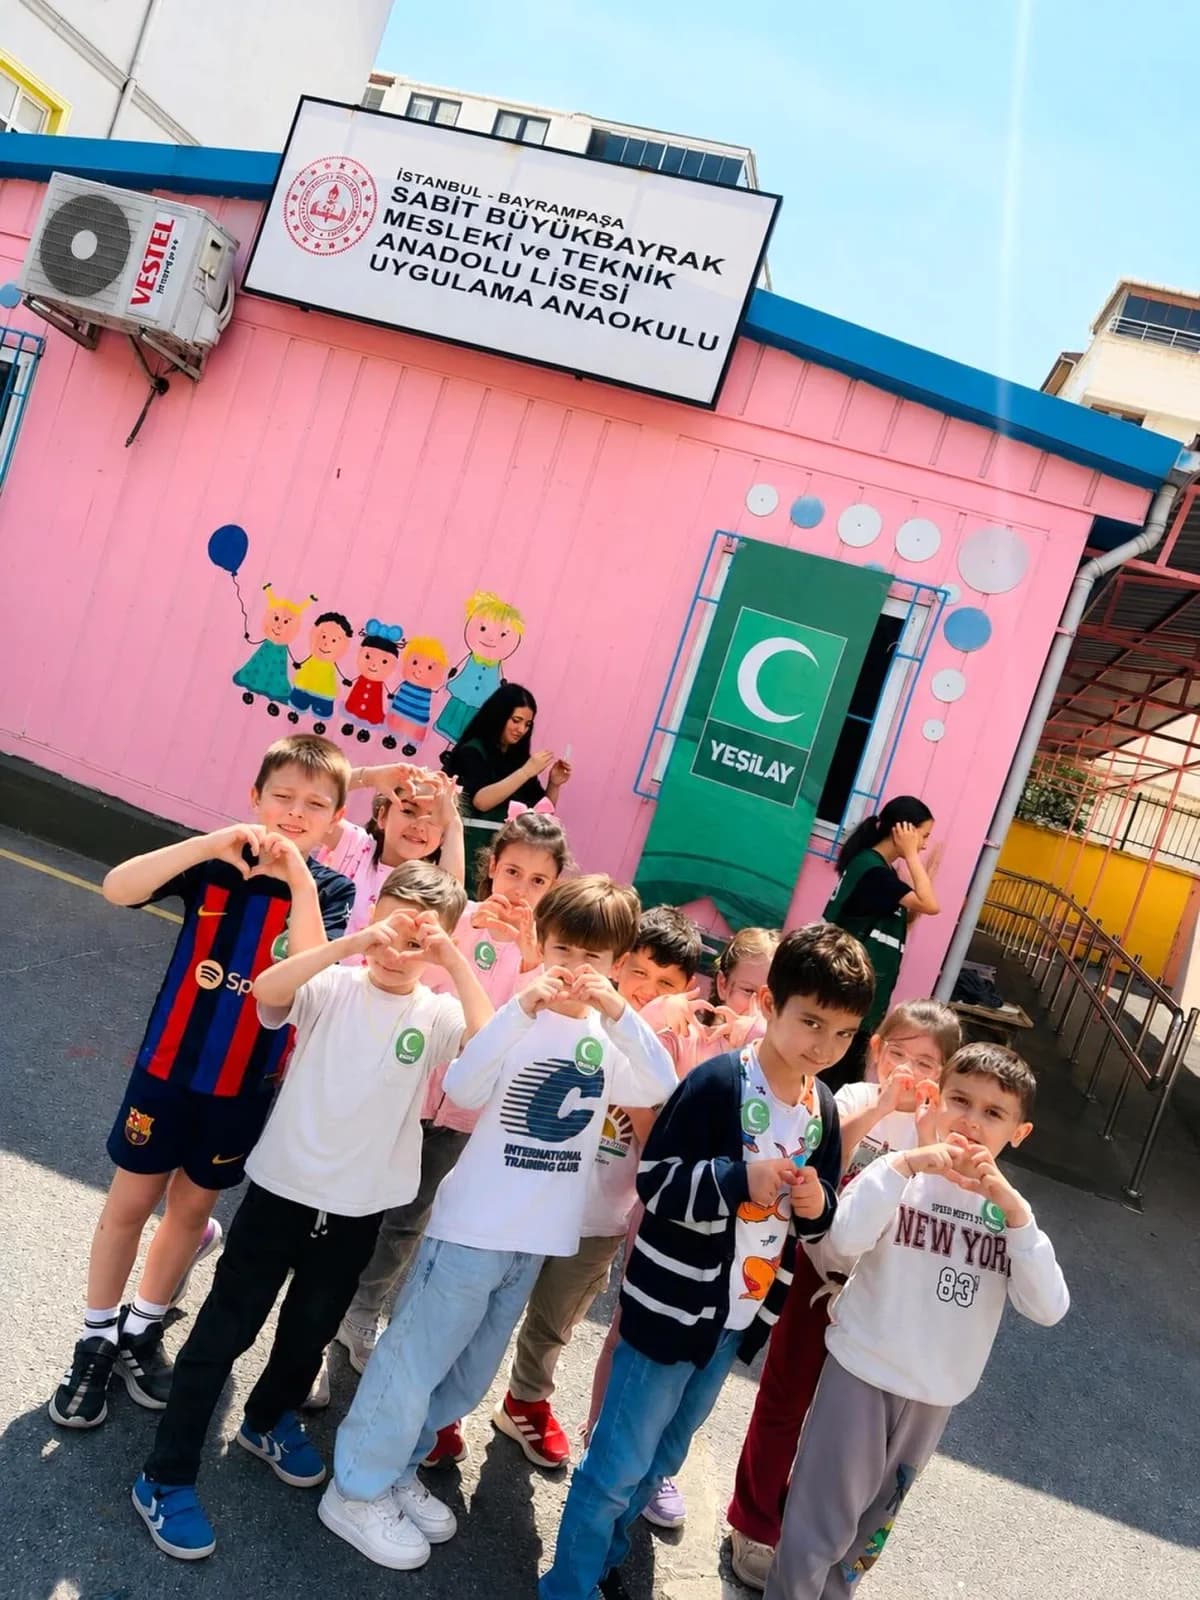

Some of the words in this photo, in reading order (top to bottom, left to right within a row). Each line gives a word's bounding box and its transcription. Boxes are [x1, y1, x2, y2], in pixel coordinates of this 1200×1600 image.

[391, 186, 479, 219] SABİT
[486, 207, 726, 275] BÜYÜKBAYRAK
[397, 168, 482, 198] İSTANBUL
[498, 193, 625, 229] BAYRAMPAŞA
[130, 219, 175, 304] VESTEL
[376, 233, 522, 278] ANADOLU
[530, 267, 630, 304] LİSESİ
[383, 208, 513, 252] MESLEKİ
[520, 243, 551, 260] ve
[562, 248, 677, 289] TEKNİK
[369, 254, 534, 307] UYGULAMA
[540, 295, 719, 351] ANAOKULU
[225, 972, 255, 997] Sp
[504, 1143, 582, 1161] INTERNATIONAL
[504, 1155, 555, 1172] TRAINING
[556, 1162, 580, 1173] CLUB
[893, 1203, 956, 1258] NEW
